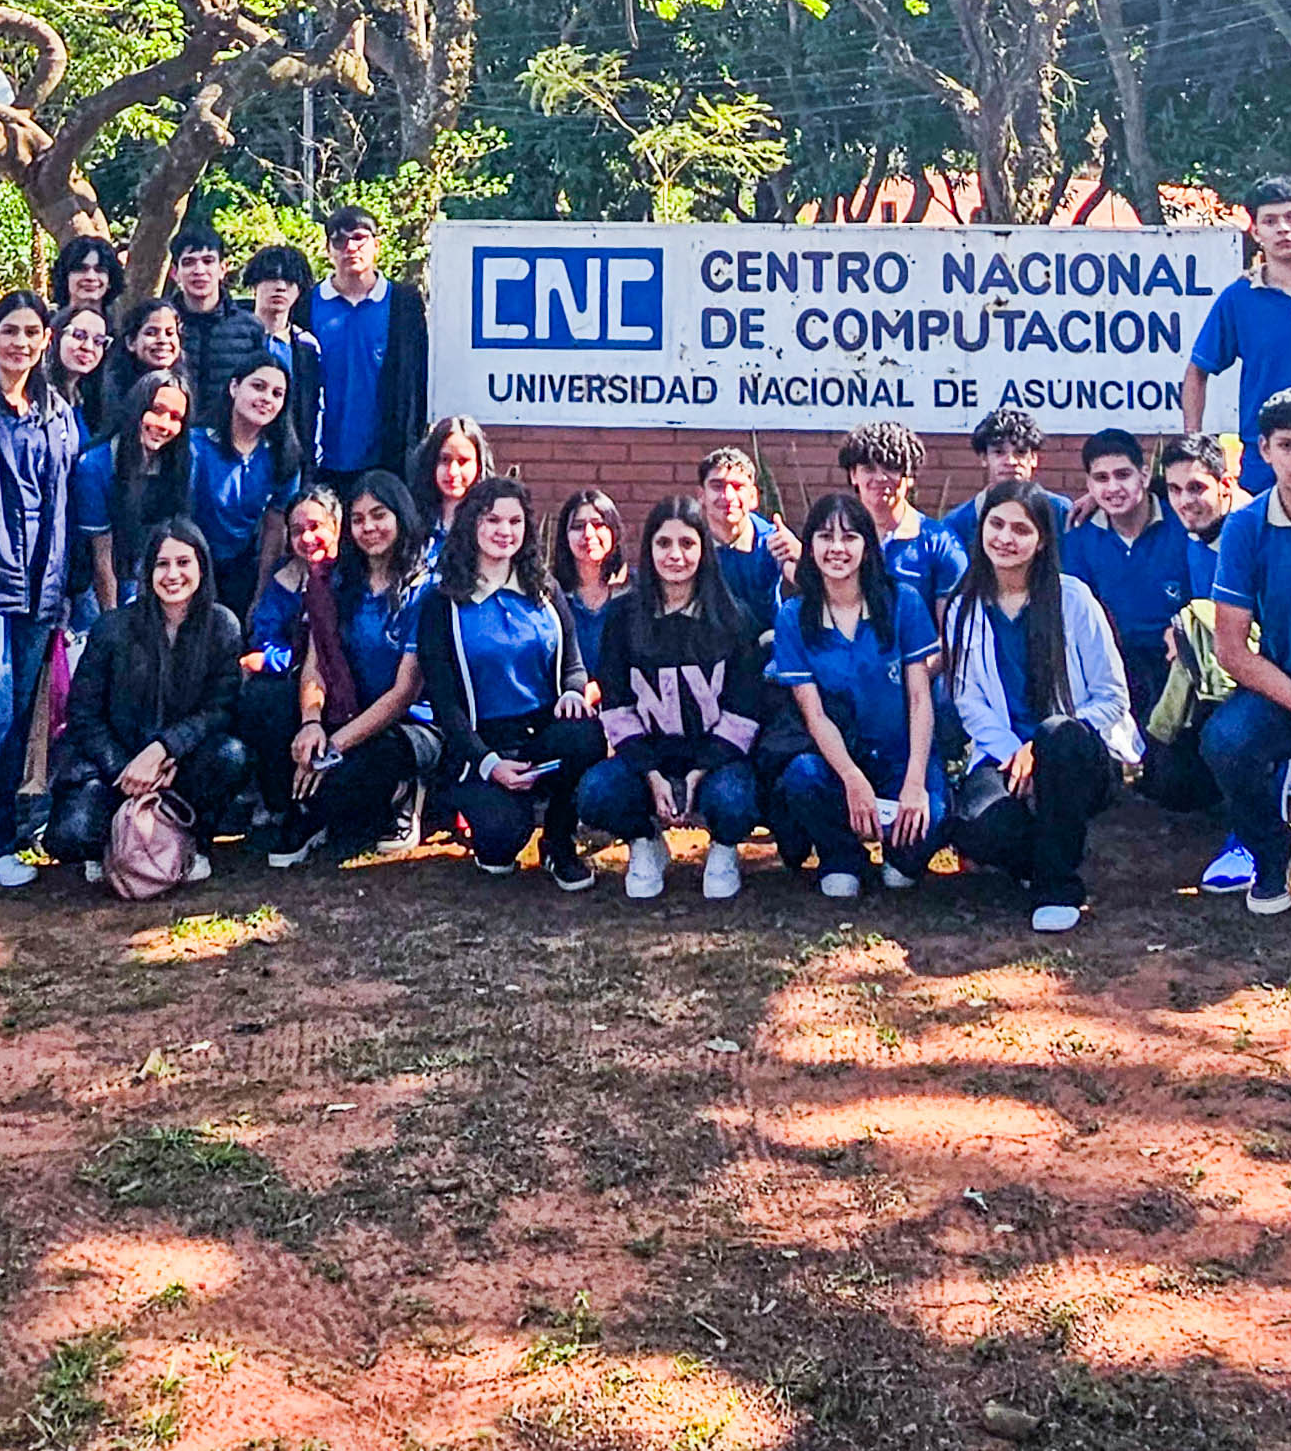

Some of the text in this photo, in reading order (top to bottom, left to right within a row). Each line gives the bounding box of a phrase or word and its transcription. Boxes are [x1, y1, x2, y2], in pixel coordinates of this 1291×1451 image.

[701, 250, 1213, 296] CENTRO NACIONAL
[482, 257, 655, 341] CNC
[701, 307, 1181, 354] DE COMPUTACION
[488, 373, 1184, 410] UNIVERSIDAD NACIONAL DE ASUNCION
[630, 659, 726, 736] NY
